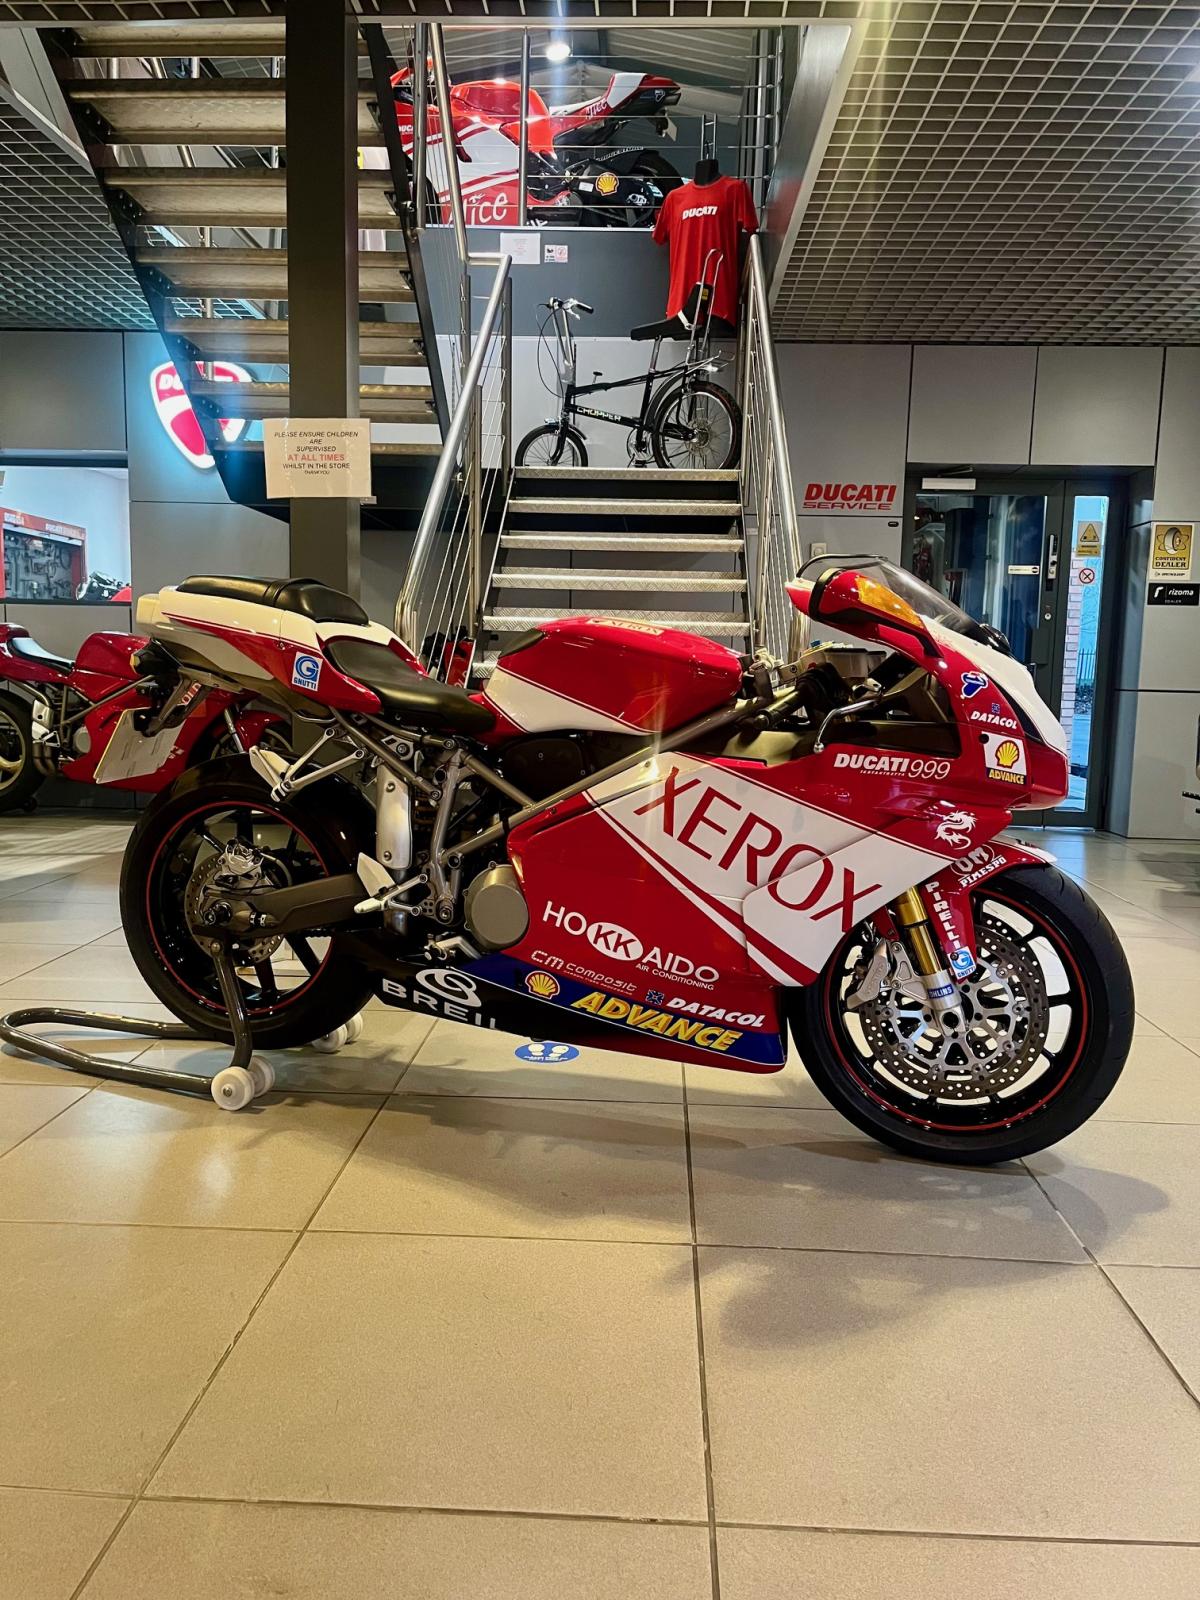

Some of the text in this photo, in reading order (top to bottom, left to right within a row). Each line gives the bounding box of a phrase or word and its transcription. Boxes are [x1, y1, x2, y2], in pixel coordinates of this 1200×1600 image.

[448, 192, 508, 226] lice
[682, 205, 718, 220] DUCATI
[576, 406, 622, 422] CHOPPER
[287, 454, 345, 462] AT ALL TIMES
[804, 483, 898, 503] DUCATI
[801, 501, 893, 511] SERVICE
[1155, 561, 1187, 569] DEALER
[1168, 588, 1195, 597] rizoma
[293, 676, 317, 690] GNUTTI
[970, 711, 1018, 730] DATACOL
[833, 753, 952, 780] DUCATI 999
[988, 769, 1026, 785] ADVANCE
[633, 766, 882, 934] XEROX
[959, 856, 1008, 889] PIMESPO
[925, 881, 962, 950] PIRELLI
[635, 962, 650, 973] AIR
[651, 968, 715, 991] CONDITIONING
[570, 991, 744, 1051] ADVANCE
[666, 997, 766, 1028] DATACOL
